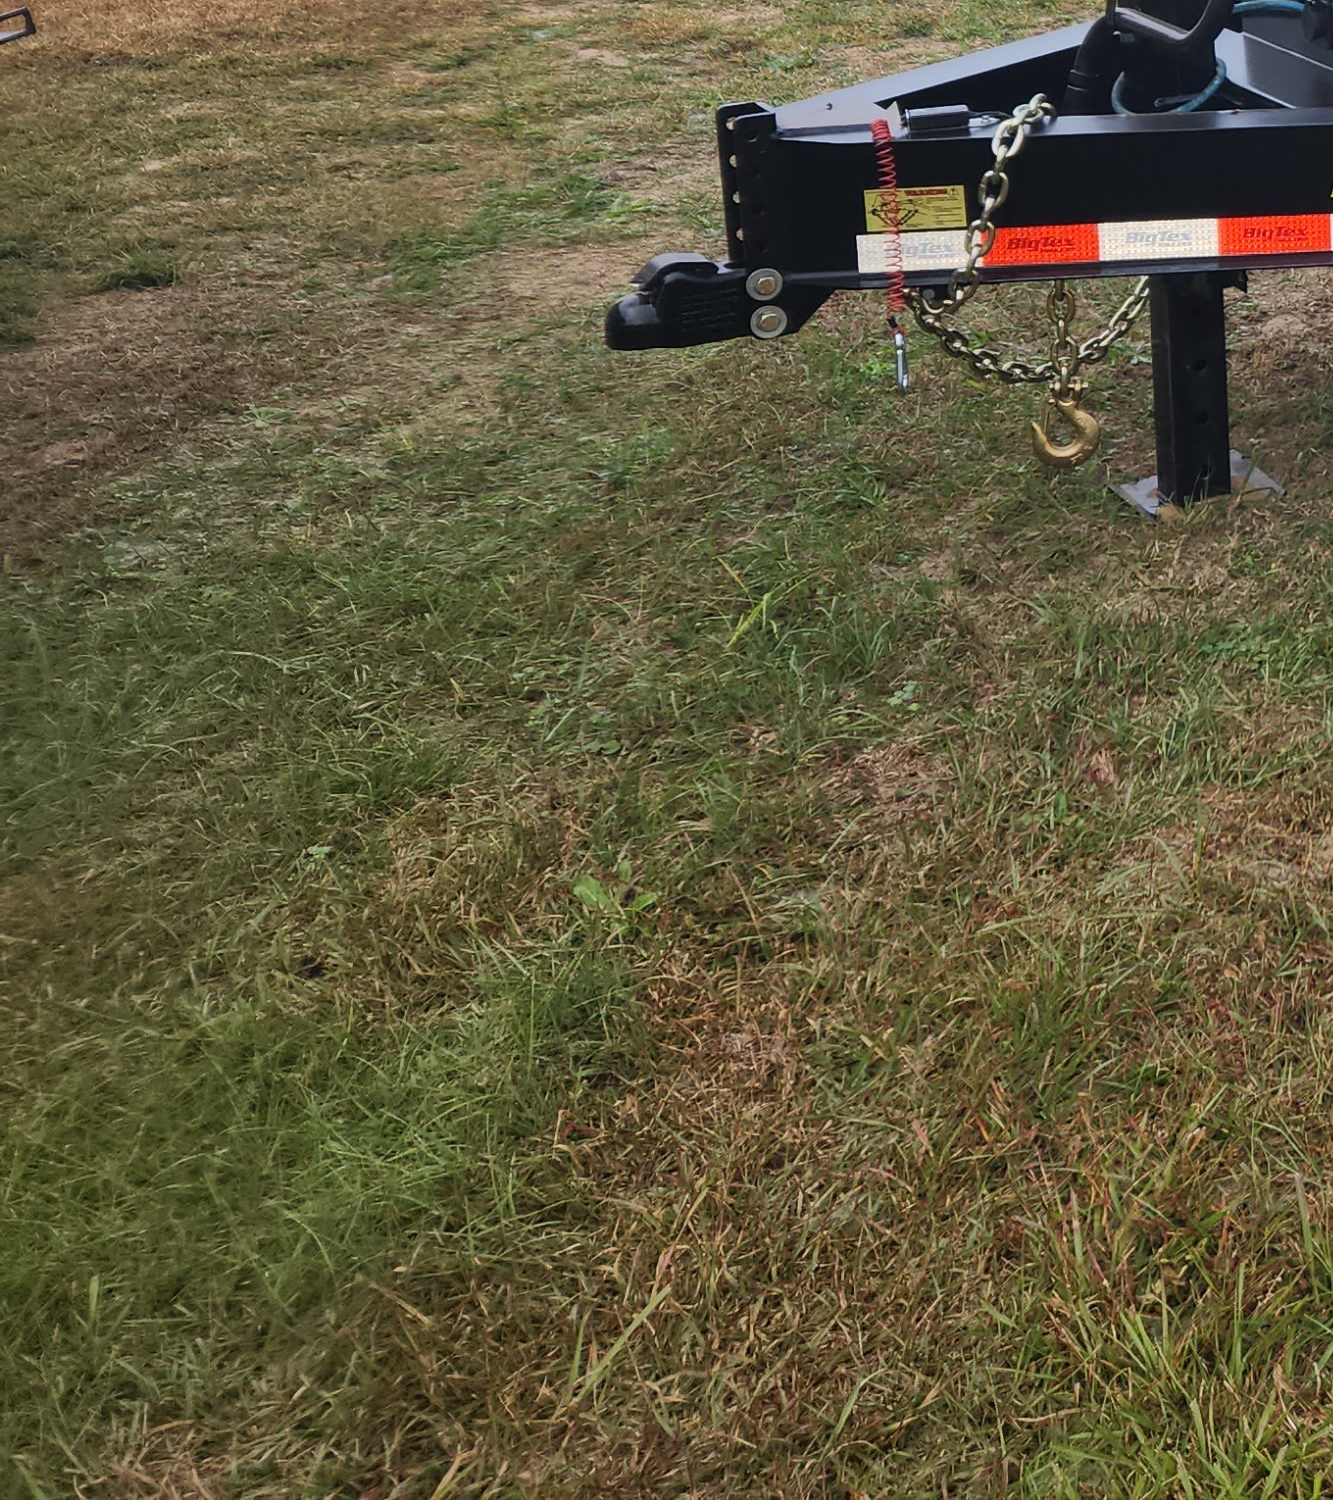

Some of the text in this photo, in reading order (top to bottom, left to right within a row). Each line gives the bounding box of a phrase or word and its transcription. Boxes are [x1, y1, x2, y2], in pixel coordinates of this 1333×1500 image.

[1126, 231, 1191, 245] BigTex
[1243, 226, 1308, 240] BigTex
[1008, 237, 1075, 251] BigTex
